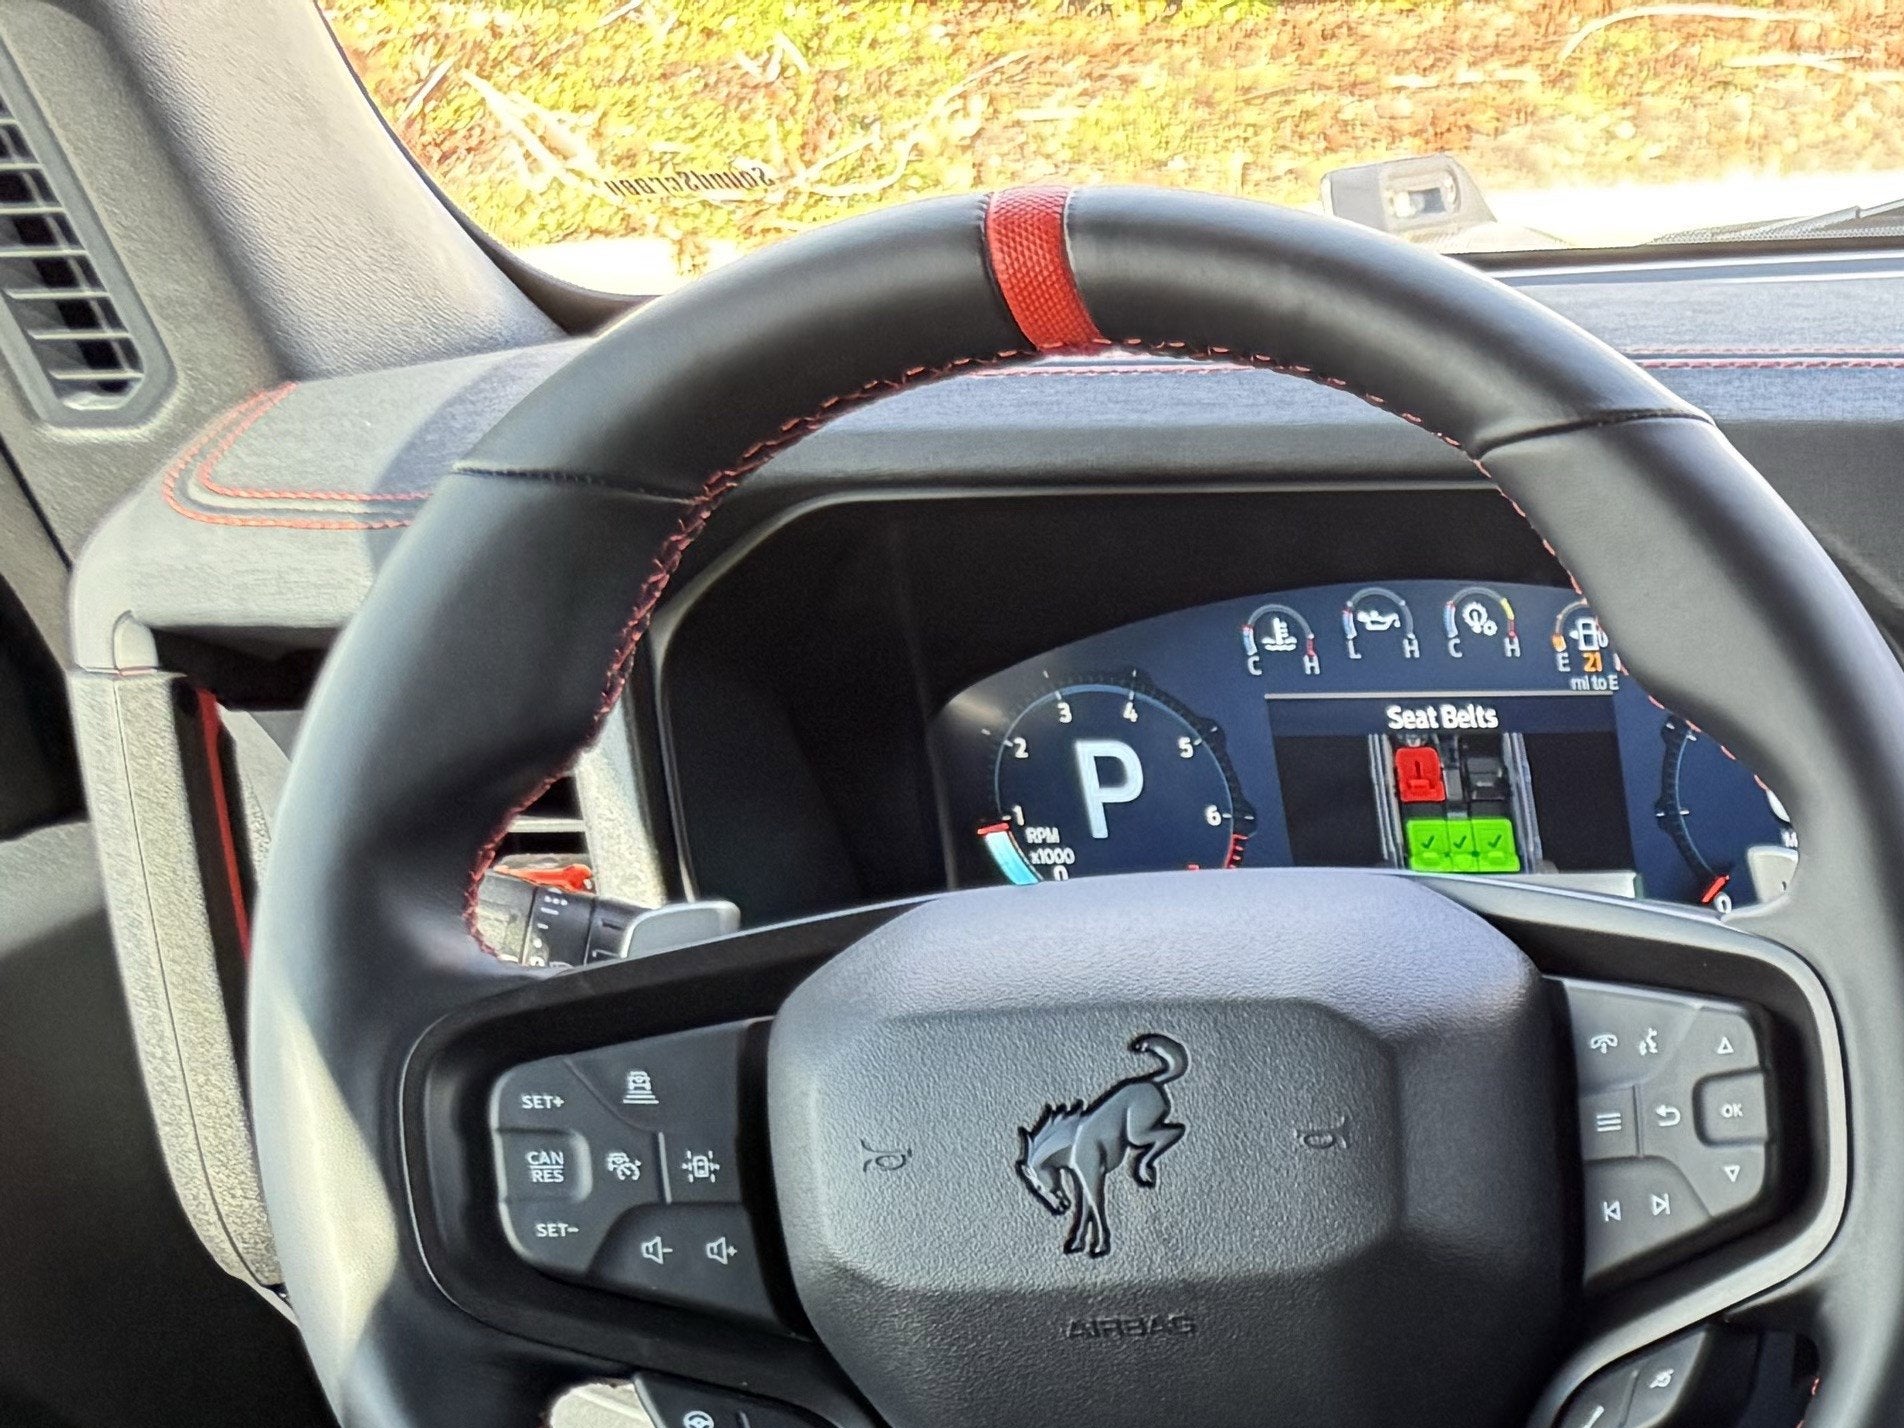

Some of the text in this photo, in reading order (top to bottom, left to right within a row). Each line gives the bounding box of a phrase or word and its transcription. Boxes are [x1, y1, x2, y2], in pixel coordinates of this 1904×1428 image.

[1346, 640, 1362, 660] L
[1402, 639, 1421, 659] H
[1448, 637, 1463, 658] C
[1504, 636, 1521, 657] H
[1247, 655, 1262, 676] C
[1303, 654, 1321, 675] H
[1582, 653, 1604, 673] 21
[1057, 702, 1072, 724] 3
[1122, 702, 1138, 723] 4
[1385, 703, 1499, 731] Seat Belts
[1013, 737, 1029, 759] 2
[1178, 736, 1194, 759] 5
[1074, 739, 1145, 839] P
[1013, 805, 1025, 826] 1
[1205, 804, 1222, 826] 6
[1025, 827, 1060, 844] RPM
[1720, 1103, 1743, 1118] OK
[527, 1151, 564, 1165] CAN
[531, 1170, 564, 1183] RES
[1064, 1313, 1198, 1340] AIRBAG
